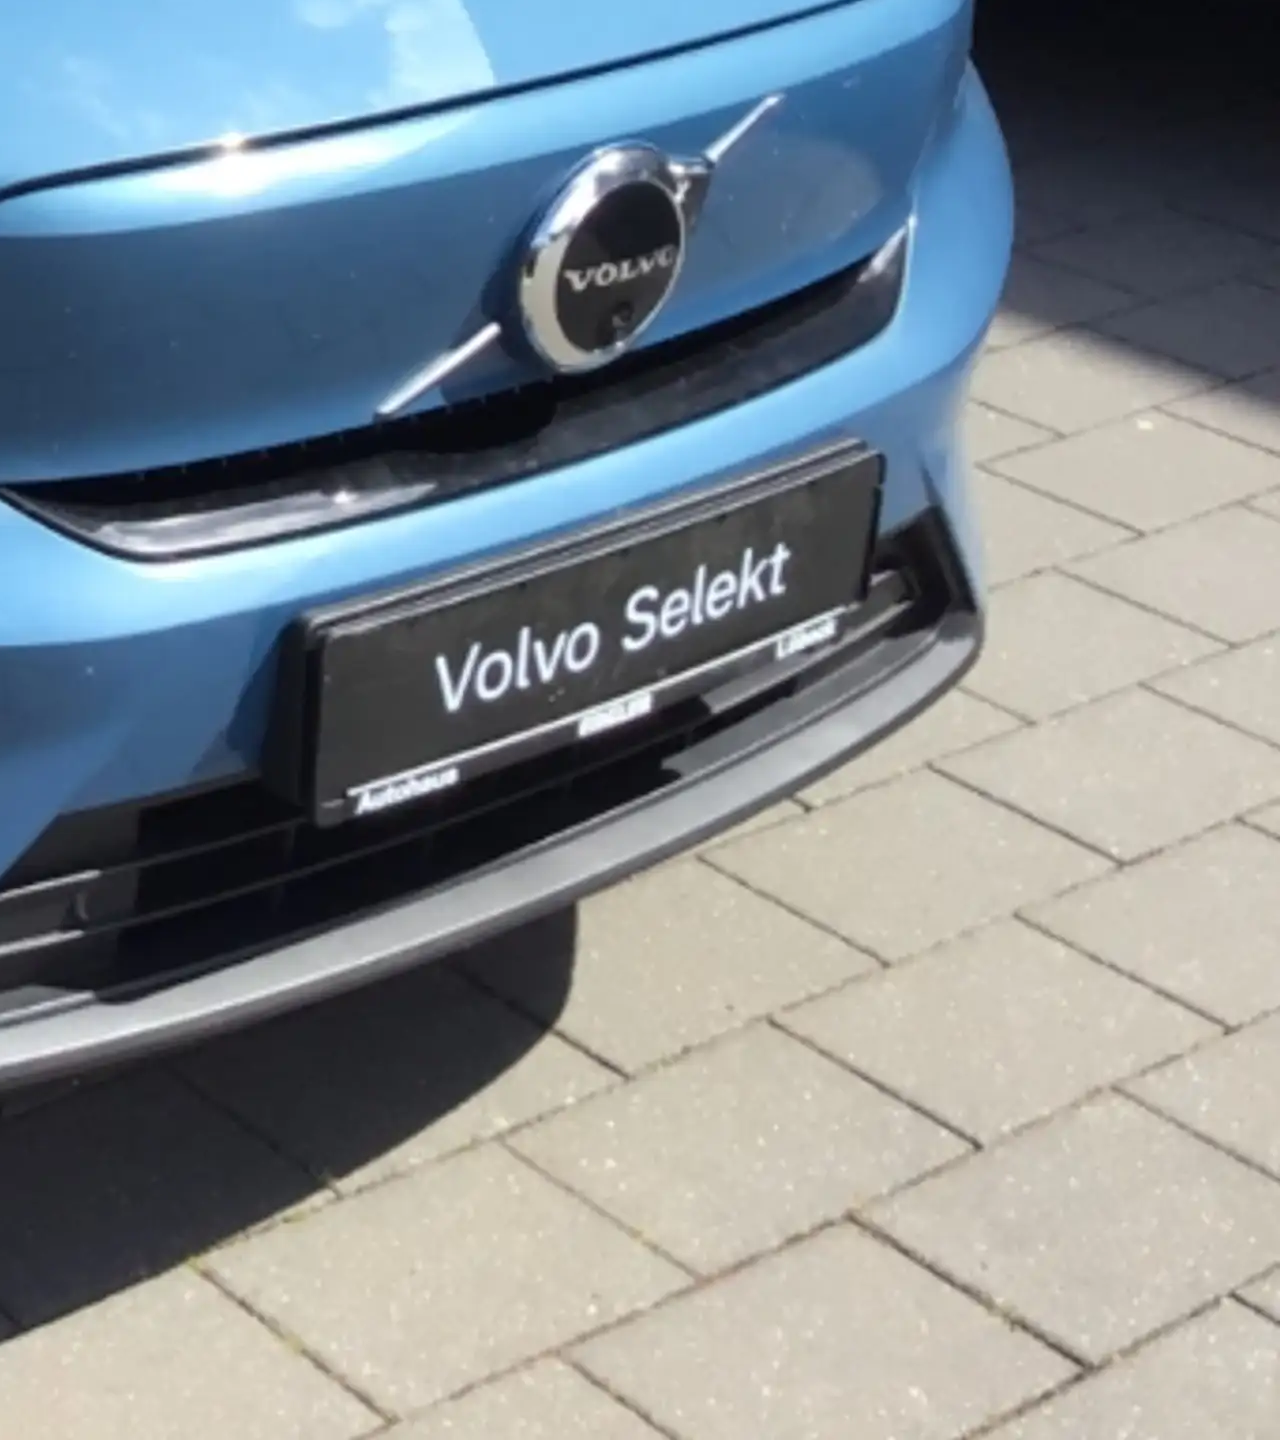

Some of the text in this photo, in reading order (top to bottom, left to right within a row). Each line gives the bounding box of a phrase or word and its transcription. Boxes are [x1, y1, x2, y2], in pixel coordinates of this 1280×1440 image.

[563, 244, 677, 292] VOLVO
[435, 623, 600, 714] Volvo
[620, 541, 793, 651] Selekt
